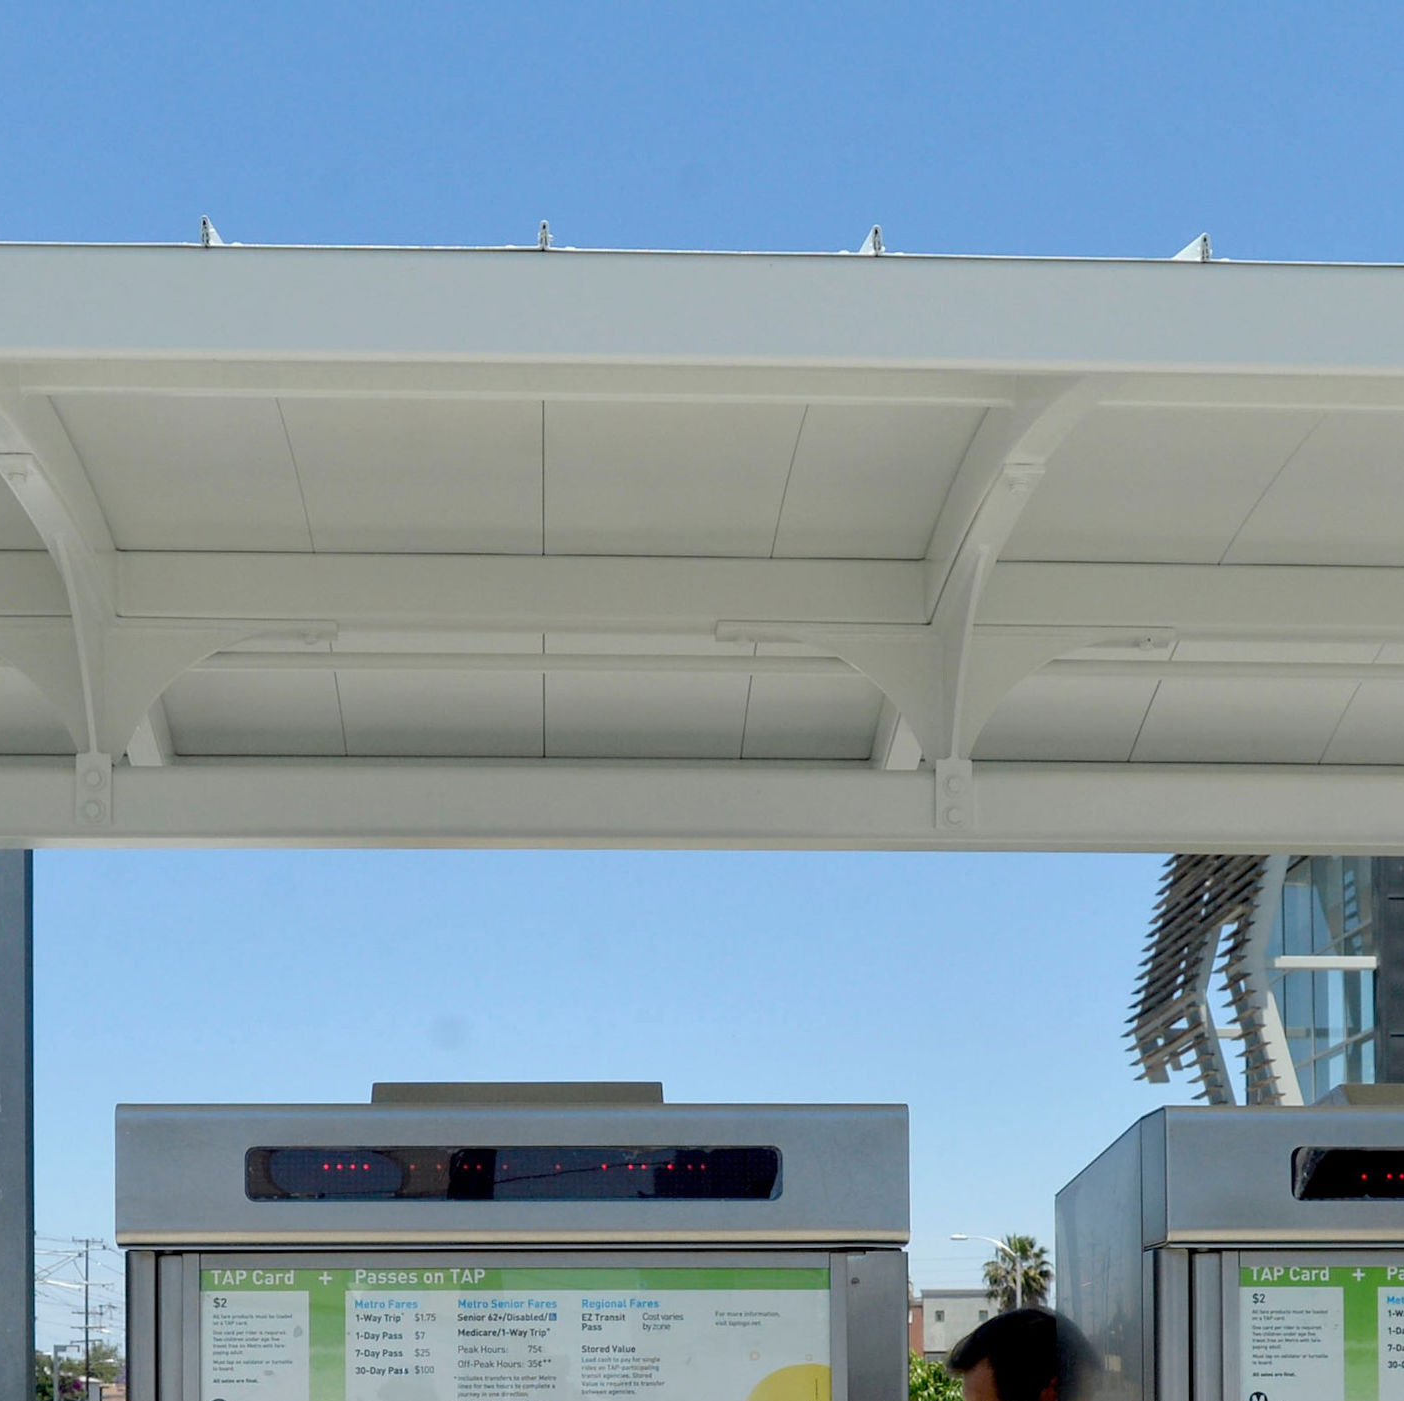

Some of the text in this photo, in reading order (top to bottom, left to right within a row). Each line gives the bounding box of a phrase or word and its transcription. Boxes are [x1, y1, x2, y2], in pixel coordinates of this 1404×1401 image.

[211, 1270, 247, 1285] TAP
[252, 1270, 295, 1285] Card
[355, 1269, 419, 1284] Passes
[423, 1271, 445, 1284] on
[449, 1269, 485, 1284] TAP
[1250, 1267, 1285, 1282] TAP
[1289, 1267, 1330, 1282] Card
[212, 1297, 228, 1309] $2
[457, 1299, 557, 1309] Metro Senior Fares
[1252, 1293, 1267, 1305] $2
[355, 1300, 418, 1309] Metro Fares
[581, 1299, 660, 1310] Regional Fares
[355, 1314, 381, 1323] 1-Way
[414, 1313, 436, 1323] $1.75
[581, 1313, 626, 1322] EZ Transit
[642, 1312, 661, 1321] Cost
[581, 1323, 603, 1332] Pass
[355, 1331, 425, 1341] 1-Day Pass $7
[355, 1348, 431, 1359] 7-Day Pass $25
[581, 1345, 636, 1353] Stored Value
[355, 1366, 435, 1376] 30-Day Pass $100
